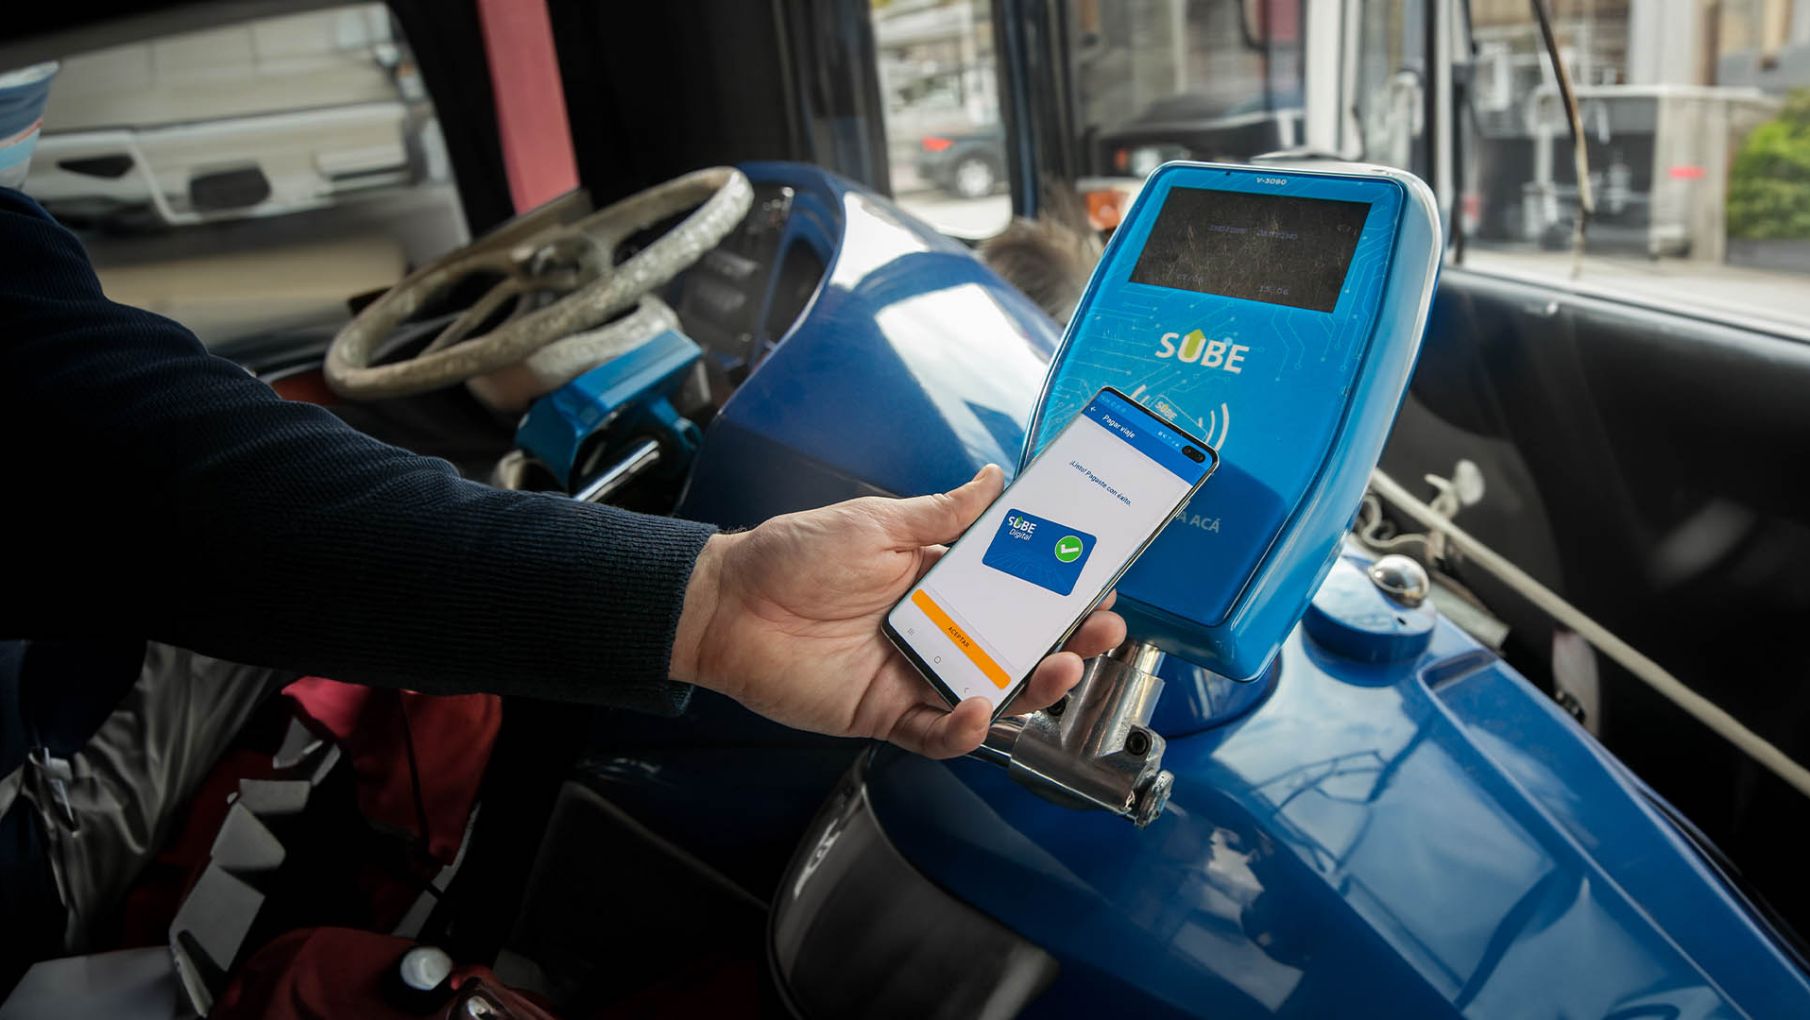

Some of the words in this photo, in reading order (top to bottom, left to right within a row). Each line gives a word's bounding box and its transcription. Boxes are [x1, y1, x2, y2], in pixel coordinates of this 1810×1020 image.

[1155, 329, 1250, 374] SUBE
[1154, 401, 1178, 421] SUBE
[1102, 414, 1121, 428] Pagar
[1119, 426, 1136, 439] viaje
[1085, 470, 1107, 488] Pagaste
[1106, 486, 1118, 496] con
[1008, 515, 1037, 534] SUBE
[1189, 513, 1221, 534] ACÁ
[1009, 528, 1033, 541] Digital
[947, 626, 970, 648] ACEPTAR
